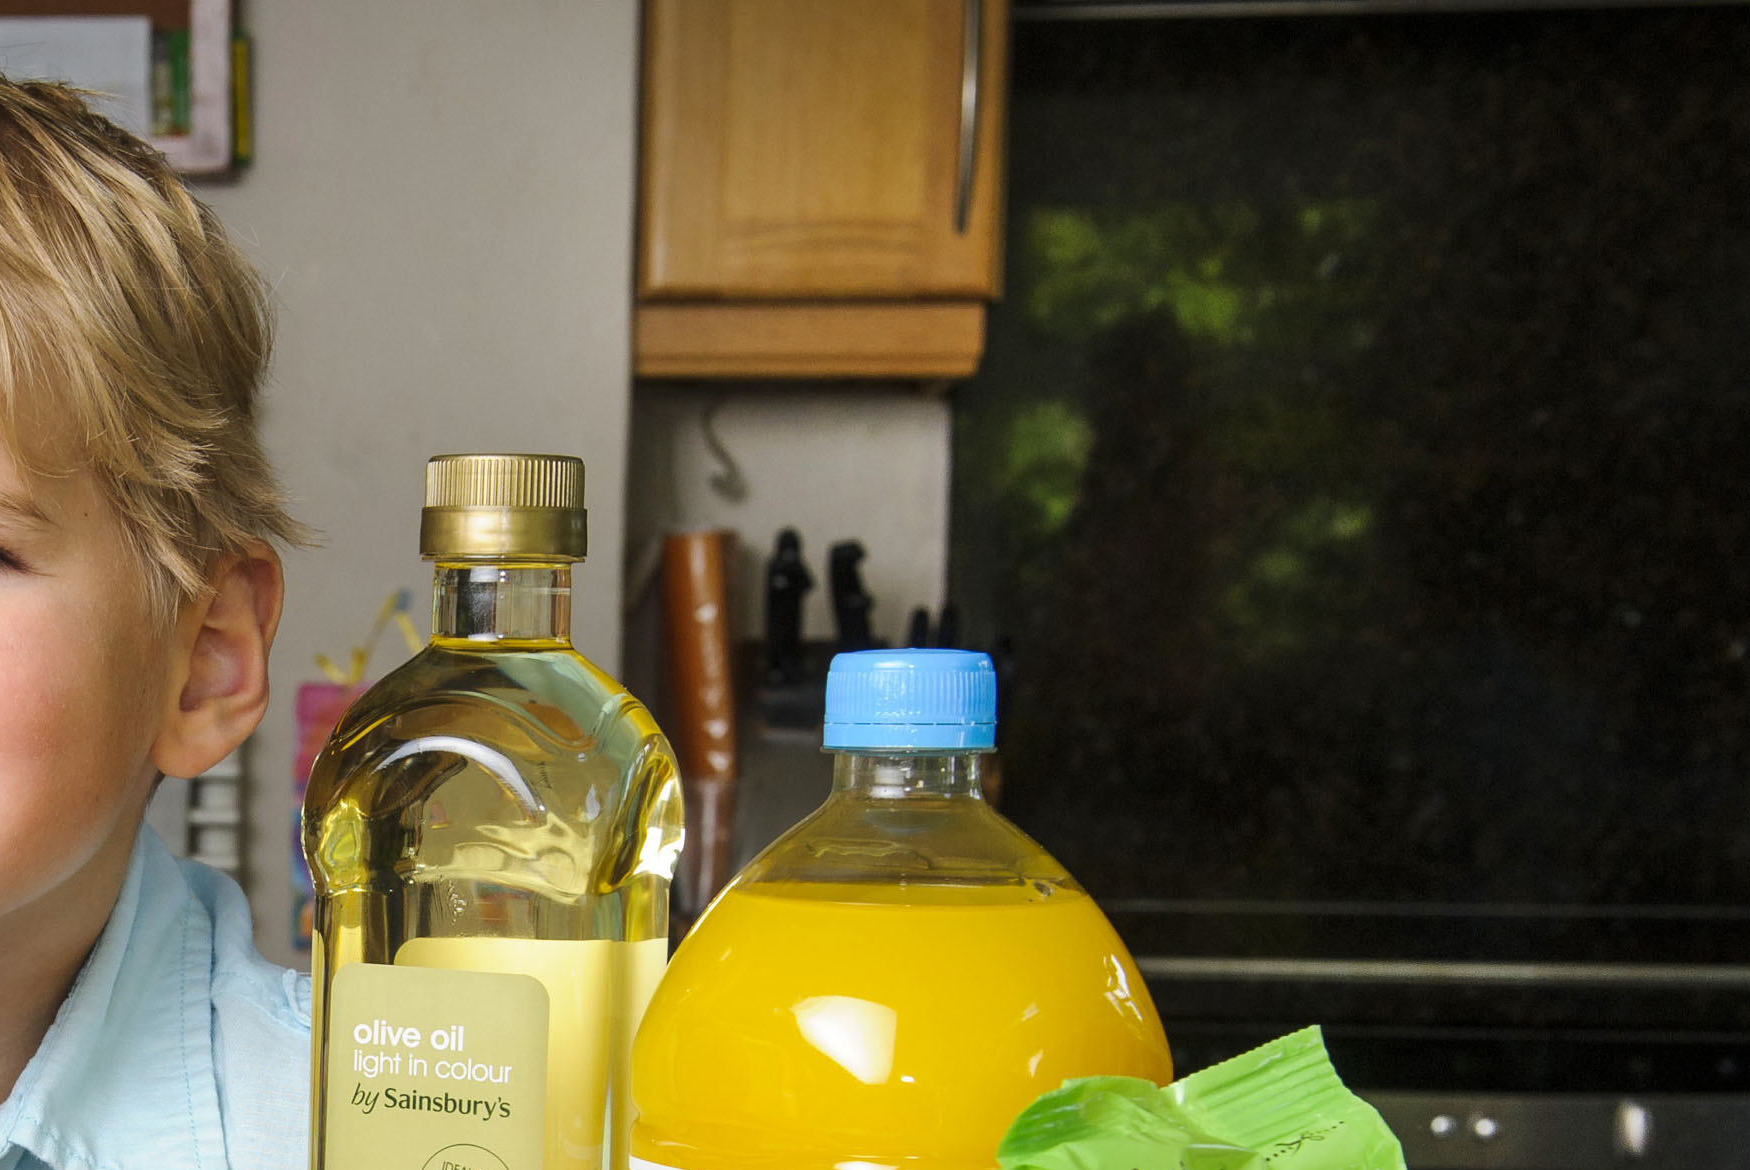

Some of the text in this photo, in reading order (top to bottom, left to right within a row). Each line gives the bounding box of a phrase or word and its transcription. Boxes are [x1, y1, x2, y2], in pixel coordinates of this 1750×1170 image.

[354, 1019, 464, 1051] olive oil
[354, 1050, 512, 1083] light in colour
[351, 1083, 511, 1121] by Sainsbury's
